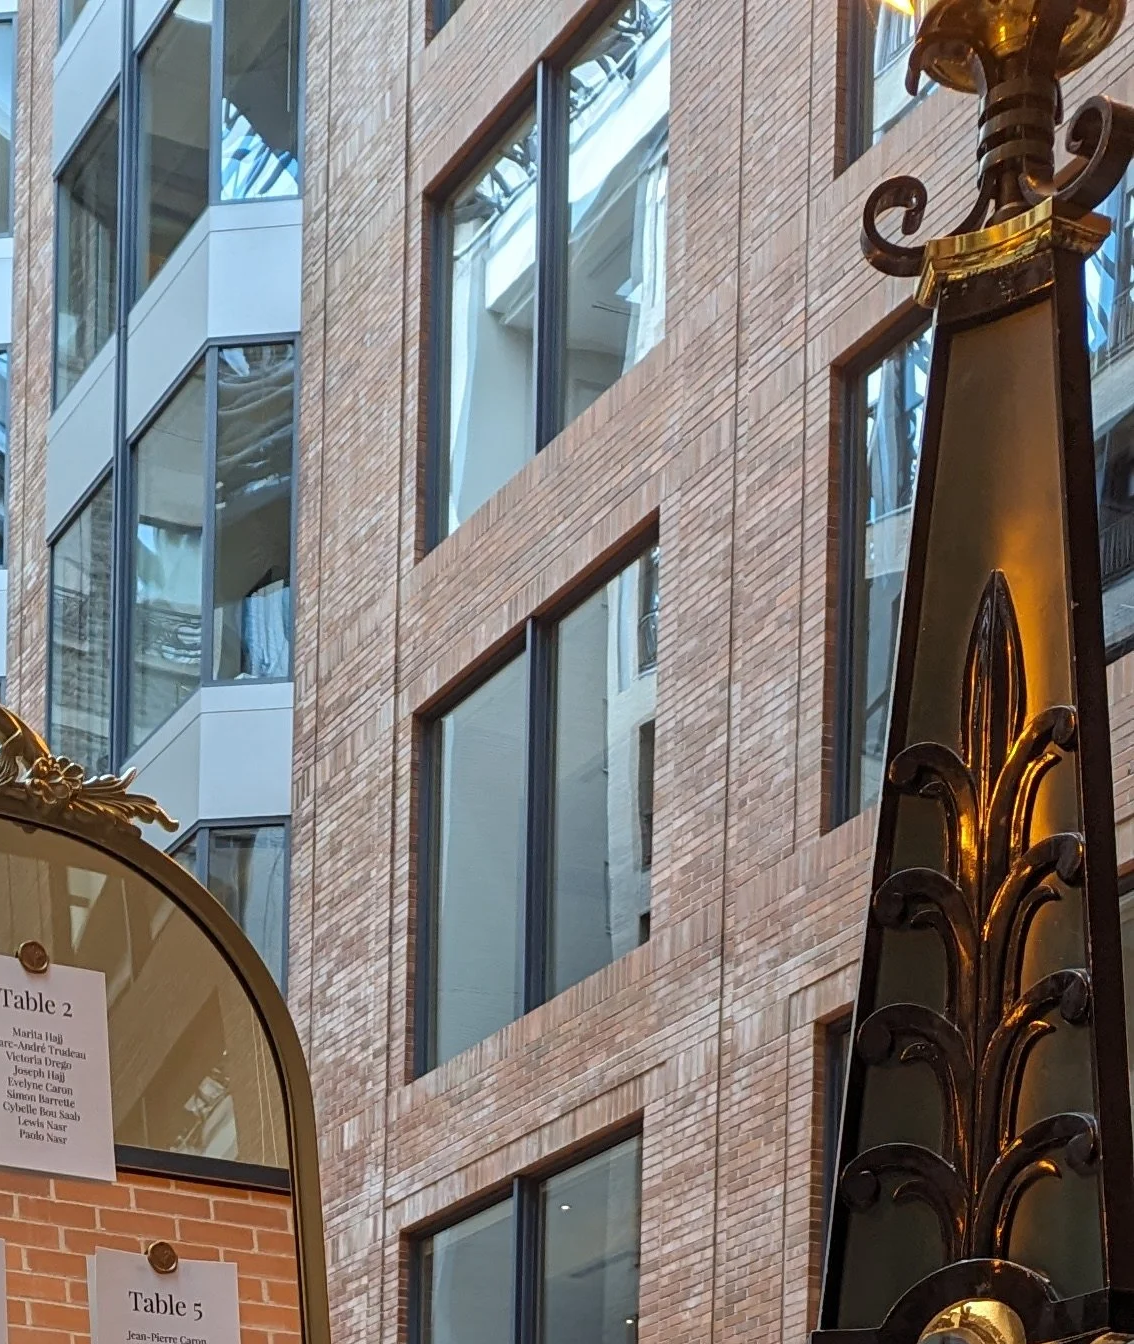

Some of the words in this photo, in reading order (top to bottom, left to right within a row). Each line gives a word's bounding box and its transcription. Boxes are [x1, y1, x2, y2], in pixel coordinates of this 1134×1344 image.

[62, 1002, 72, 1018] 2
[6, 1051, 42, 1065] Victoria
[45, 1057, 72, 1070] Drego
[8, 1076, 43, 1091] Evelyne
[46, 1082, 73, 1096] Caron
[7, 1089, 36, 1102] Simon
[18, 1116, 44, 1128] Lewis
[47, 1120, 67, 1132] Nasr
[128, 1290, 186, 1316] Table
[194, 1302, 202, 1321] 5
[126, 1330, 178, 1344] Jean-Pierre
